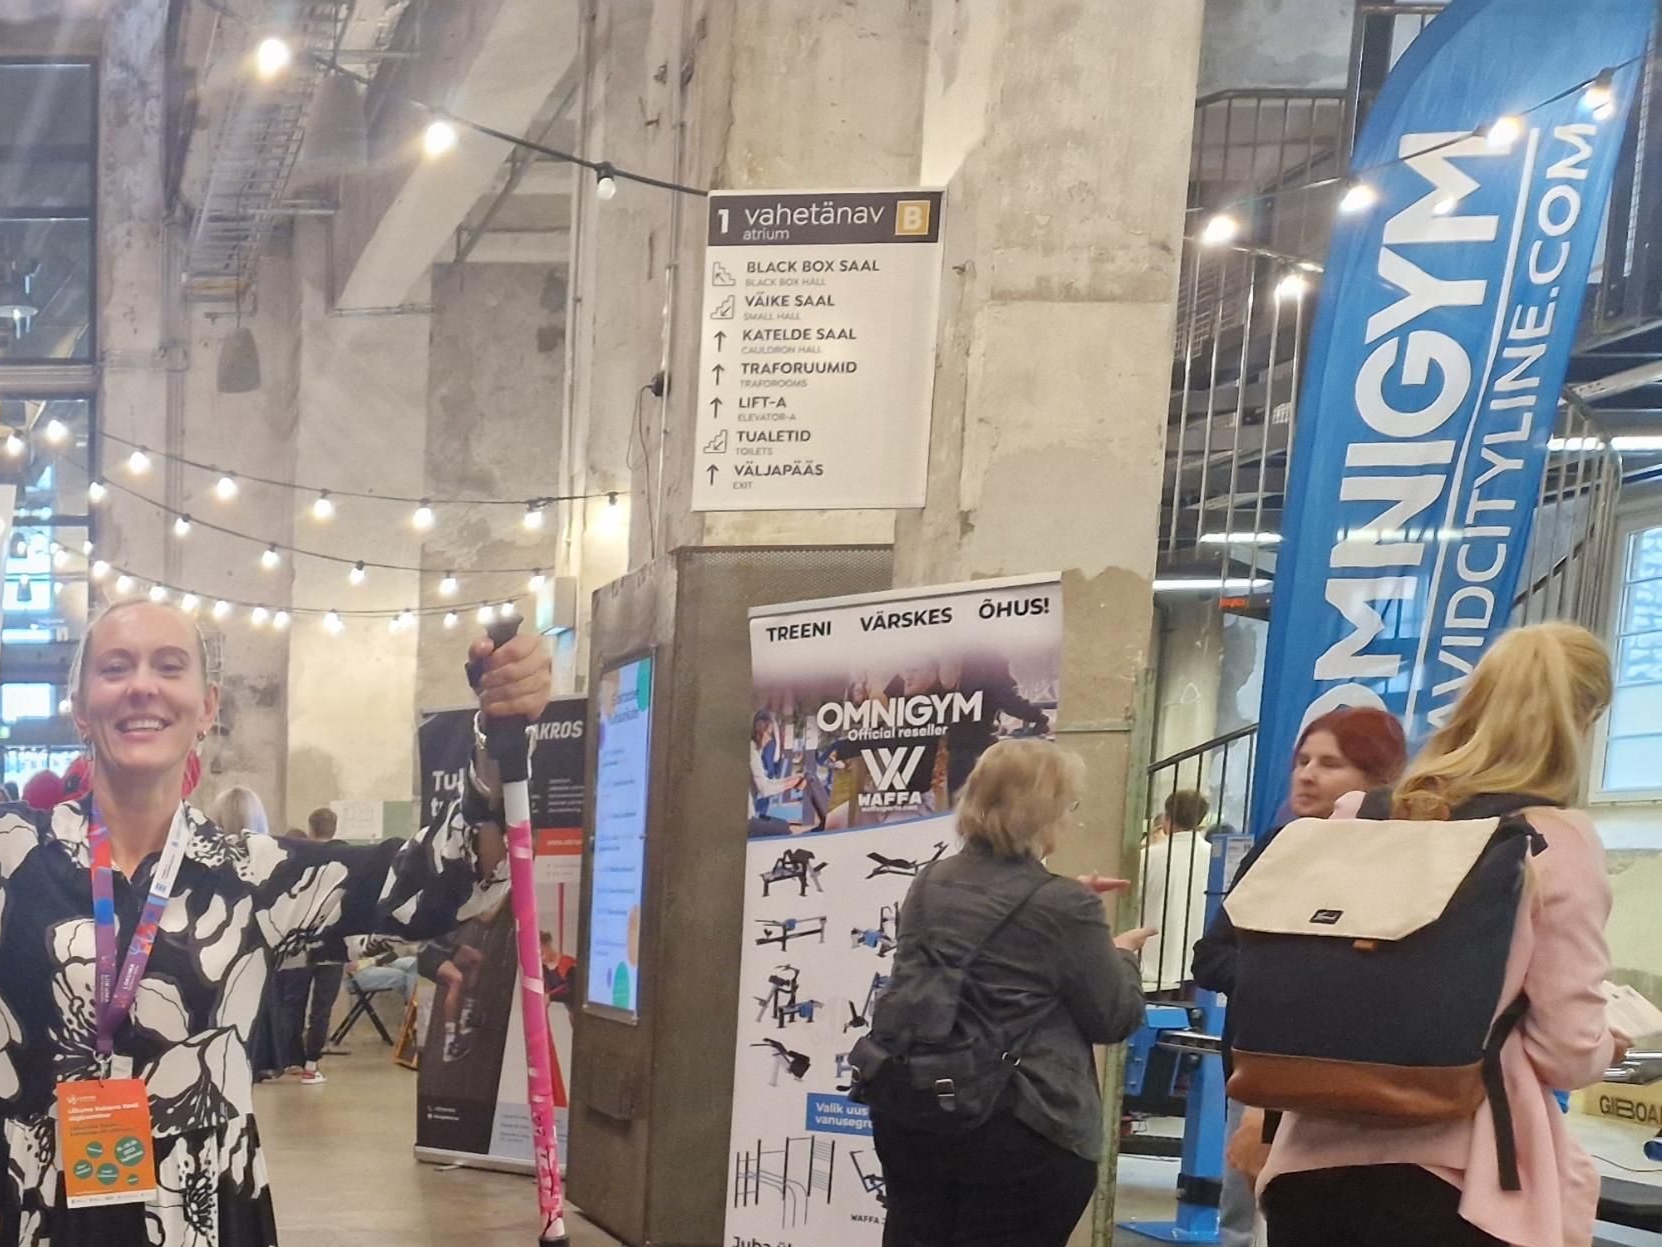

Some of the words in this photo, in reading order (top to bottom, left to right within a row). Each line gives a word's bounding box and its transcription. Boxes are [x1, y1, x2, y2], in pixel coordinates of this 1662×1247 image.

[718, 208, 730, 234] 1
[745, 201, 885, 226] vahetänav
[902, 206, 922, 230] B
[743, 227, 789, 240] atrium
[746, 261, 797, 273] BLACK
[802, 260, 835, 272] BOX
[839, 260, 880, 272] SAAL
[745, 278, 777, 287] BLACK
[779, 278, 800, 287] BOX
[802, 277, 826, 286] HALL
[745, 291, 790, 307] VÄIKE
[794, 295, 835, 307] SAAL
[743, 312, 774, 321] SMALL
[777, 312, 801, 320] HALL
[742, 328, 812, 341] KATELDE
[816, 328, 857, 340] SAAL
[741, 346, 795, 354] CAULDRON
[798, 345, 822, 354] HALL
[741, 361, 857, 374] TRAFORUUMID
[740, 379, 807, 388] TRAFOROOMS
[738, 396, 787, 408] LIFT-A
[737, 413, 796, 422] ELEVATOR-A
[736, 430, 811, 442] TUALETID
[735, 447, 773, 455] TOILETS
[734, 460, 824, 476] VÄLJAPÄÄS
[733, 481, 753, 489] EXIT
[766, 621, 832, 642] TREENI
[860, 607, 953, 631] VÄRSKES
[978, 597, 1050, 619] ÕHUS!
[817, 690, 983, 732] OMNIGYM
[848, 727, 895, 742] Official
[898, 724, 948, 739] reseller
[858, 791, 922, 807] WAFFA
[816, 1102, 843, 1114] Valik
[1599, 1094, 1662, 1125] GIBOA
[850, 1213, 879, 1225] WAFFA
